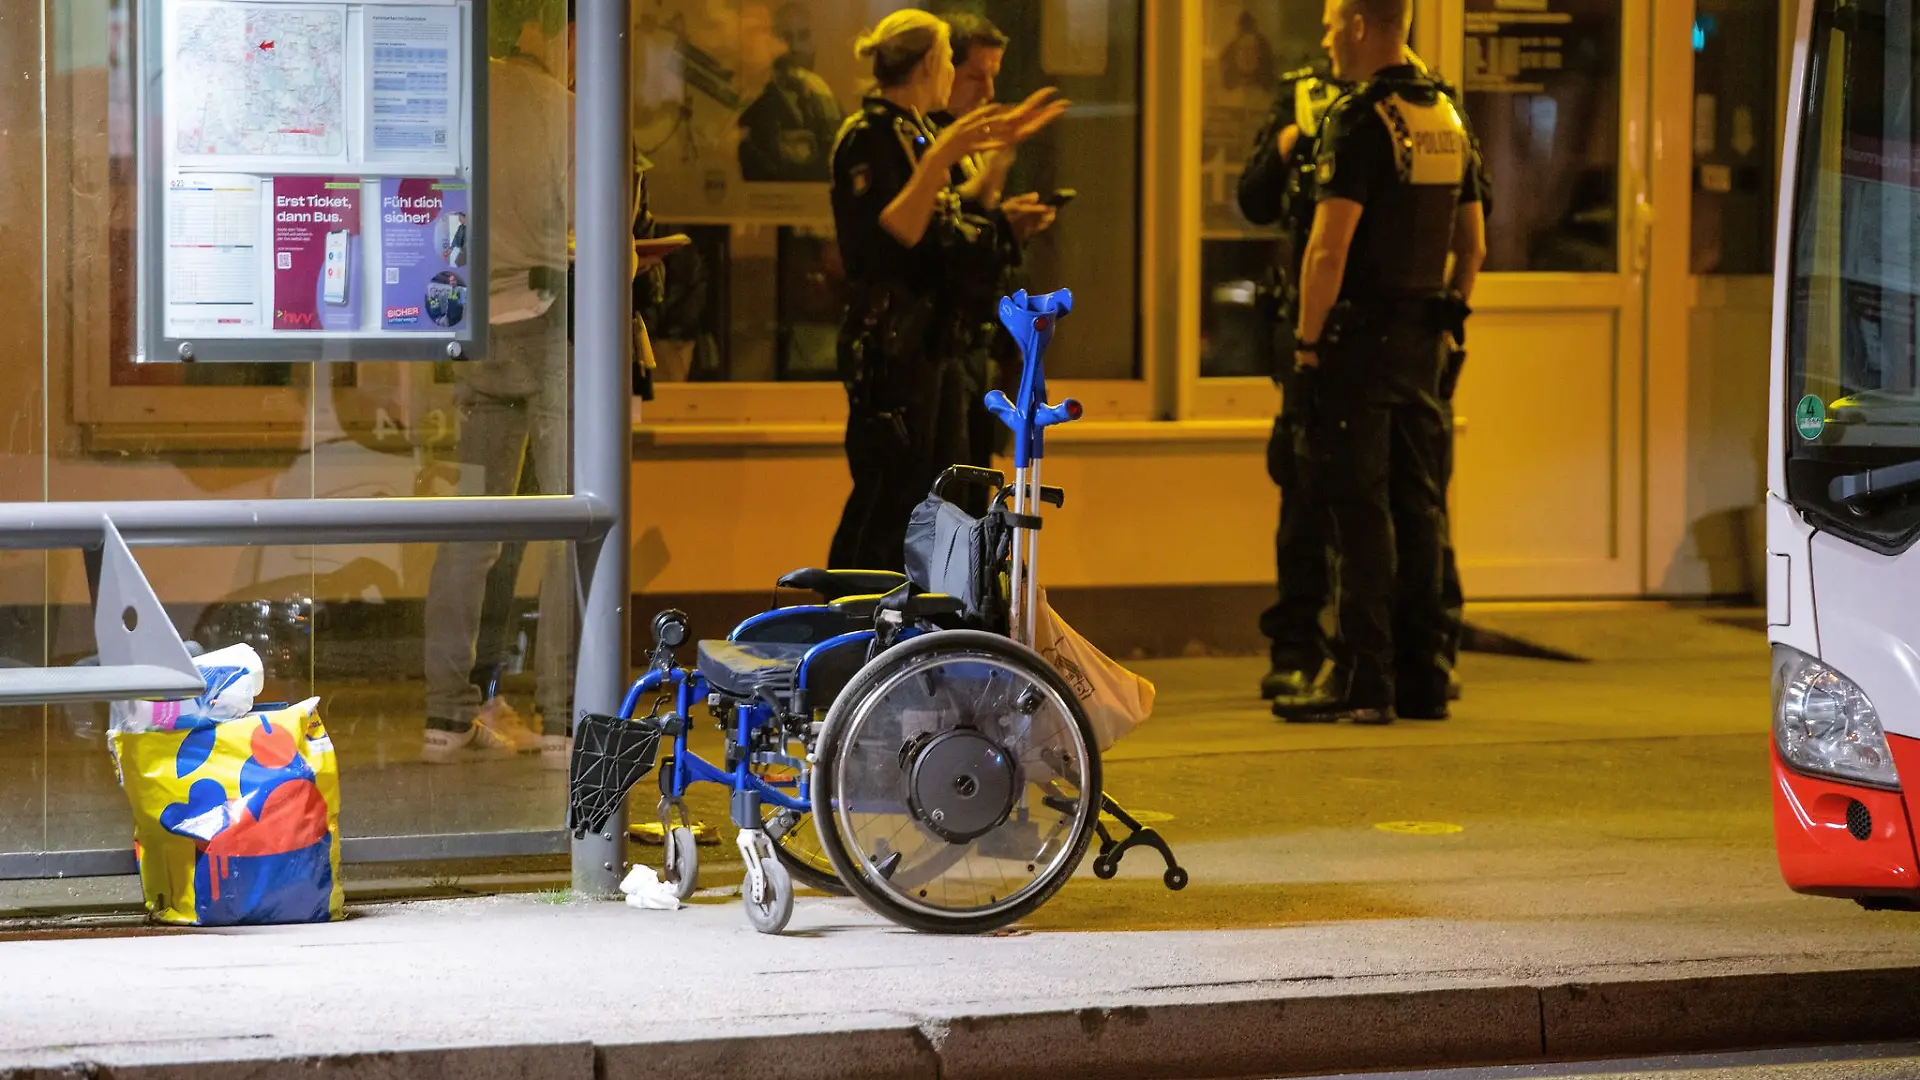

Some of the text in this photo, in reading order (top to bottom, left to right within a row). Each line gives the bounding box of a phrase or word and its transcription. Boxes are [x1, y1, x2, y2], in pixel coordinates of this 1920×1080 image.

[277, 194, 352, 209] Erst Ticket,
[384, 195, 442, 208] Fühl dich
[277, 211, 343, 222] dann Bus.
[384, 211, 430, 223] sicher!
[387, 306, 420, 318] SICHER
[1806, 397, 1815, 417] 4
